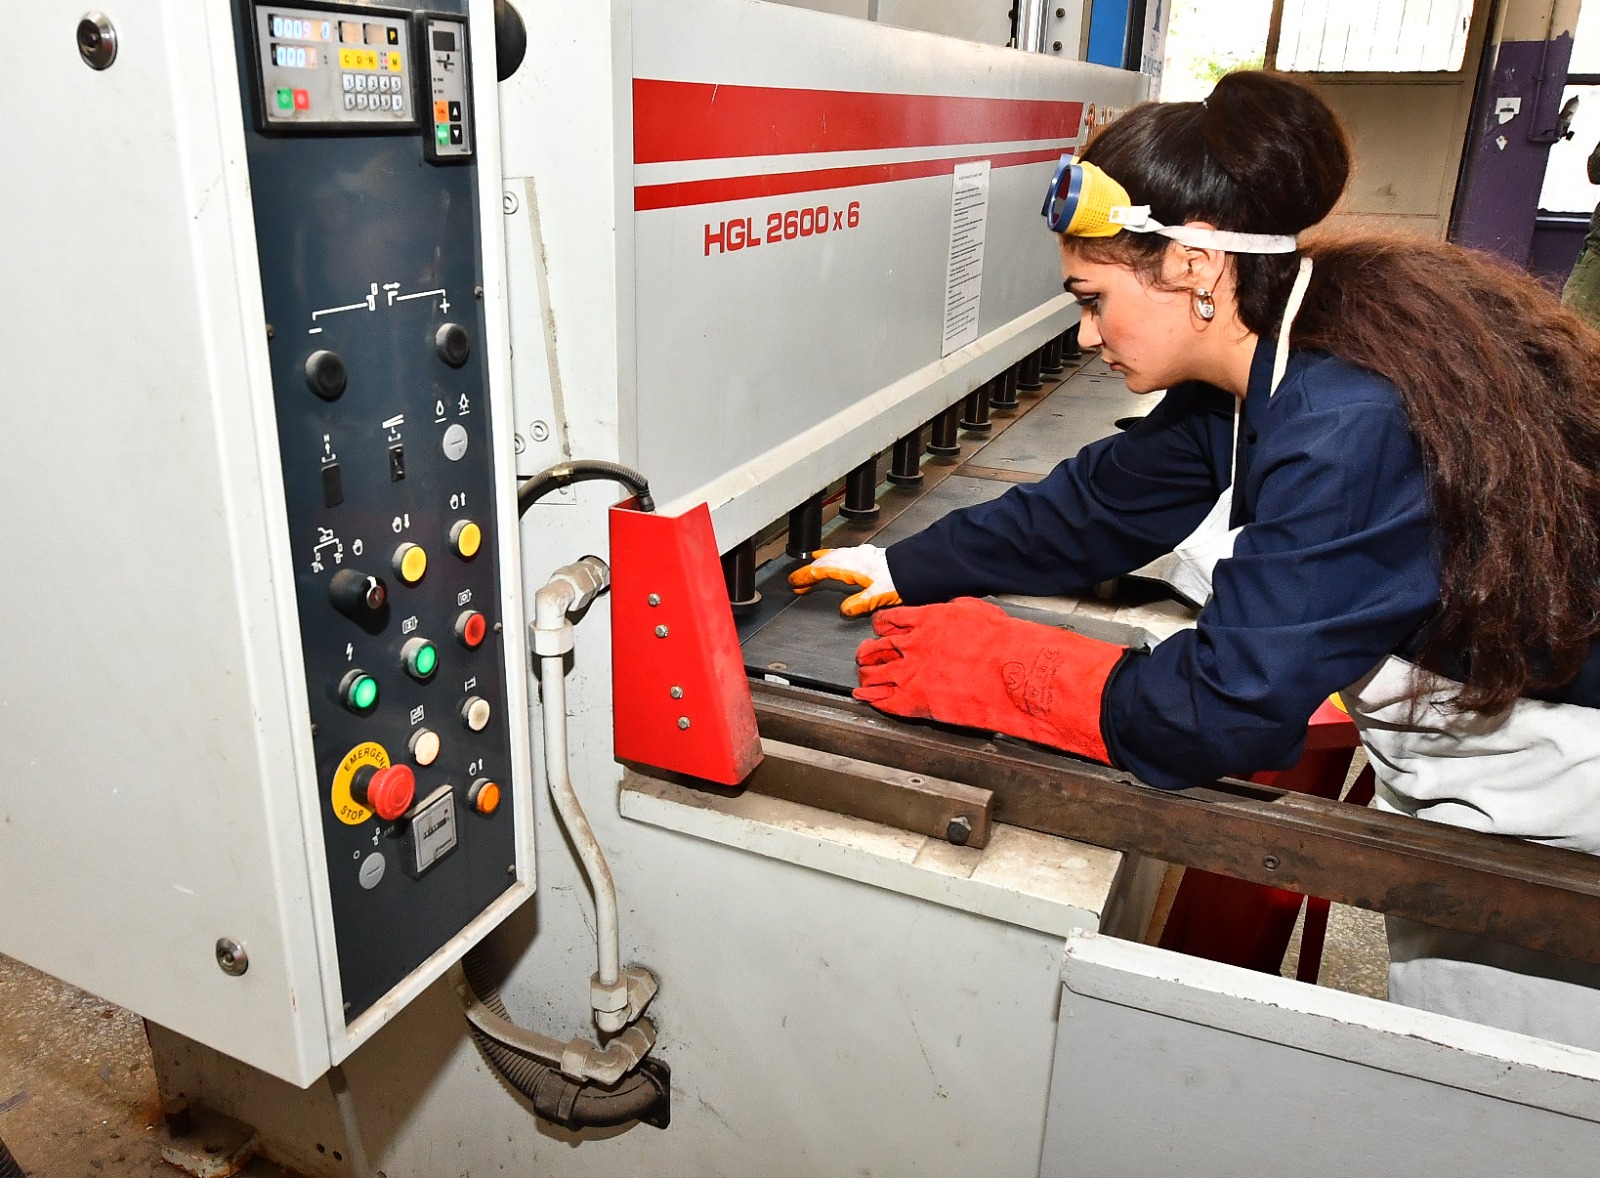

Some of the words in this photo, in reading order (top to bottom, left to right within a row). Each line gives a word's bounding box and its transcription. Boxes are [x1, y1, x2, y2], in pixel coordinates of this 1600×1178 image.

[389, 30, 396, 41] P
[704, 217, 761, 256] HGL
[767, 206, 829, 244] 2600
[832, 210, 843, 231] x
[847, 201, 860, 228] 6
[340, 805, 364, 820] STOP
